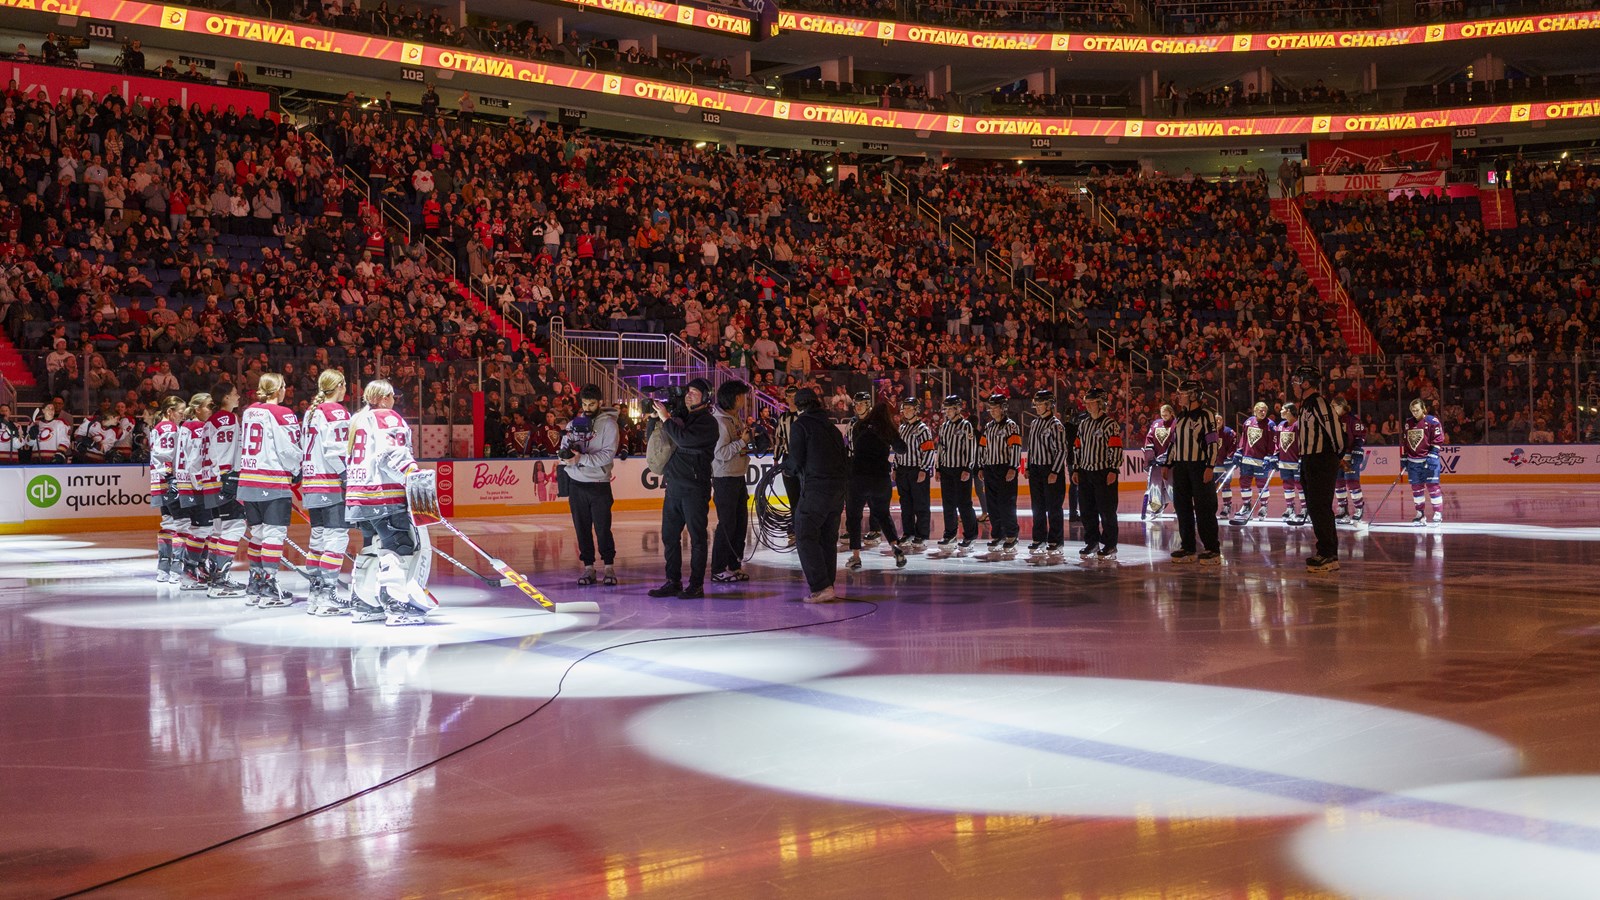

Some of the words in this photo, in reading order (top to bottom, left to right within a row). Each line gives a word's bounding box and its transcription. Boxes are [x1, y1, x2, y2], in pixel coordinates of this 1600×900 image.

[89, 25, 114, 38] 101
[206, 16, 296, 47] OTTAWA
[1460, 19, 1534, 37] OTTAWA
[908, 27, 969, 46] OTTAWA
[1083, 37, 1148, 51] OTTAWA
[1266, 34, 1336, 49] OTTAWA
[438, 52, 515, 80] OTTAWA
[402, 69, 424, 81] 102
[634, 82, 699, 105] OTTAWA
[703, 112, 720, 123] 103
[803, 106, 869, 126] OTTAWA
[1345, 116, 1417, 131] OTTAWA
[975, 119, 1042, 135] OTTAWA
[1155, 123, 1224, 136] OTTAWA
[1456, 128, 1476, 138] 105
[1032, 138, 1050, 147] 104
[1344, 175, 1382, 190] ZONE
[288, 429, 301, 444] 19
[334, 427, 349, 442] 17
[160, 437, 175, 449] 23
[1373, 457, 1388, 465] .ca
[67, 475, 121, 487] INTUIT
[473, 463, 519, 489] Barbie
[66, 489, 151, 511] quickboo
[504, 570, 554, 608] CCM
